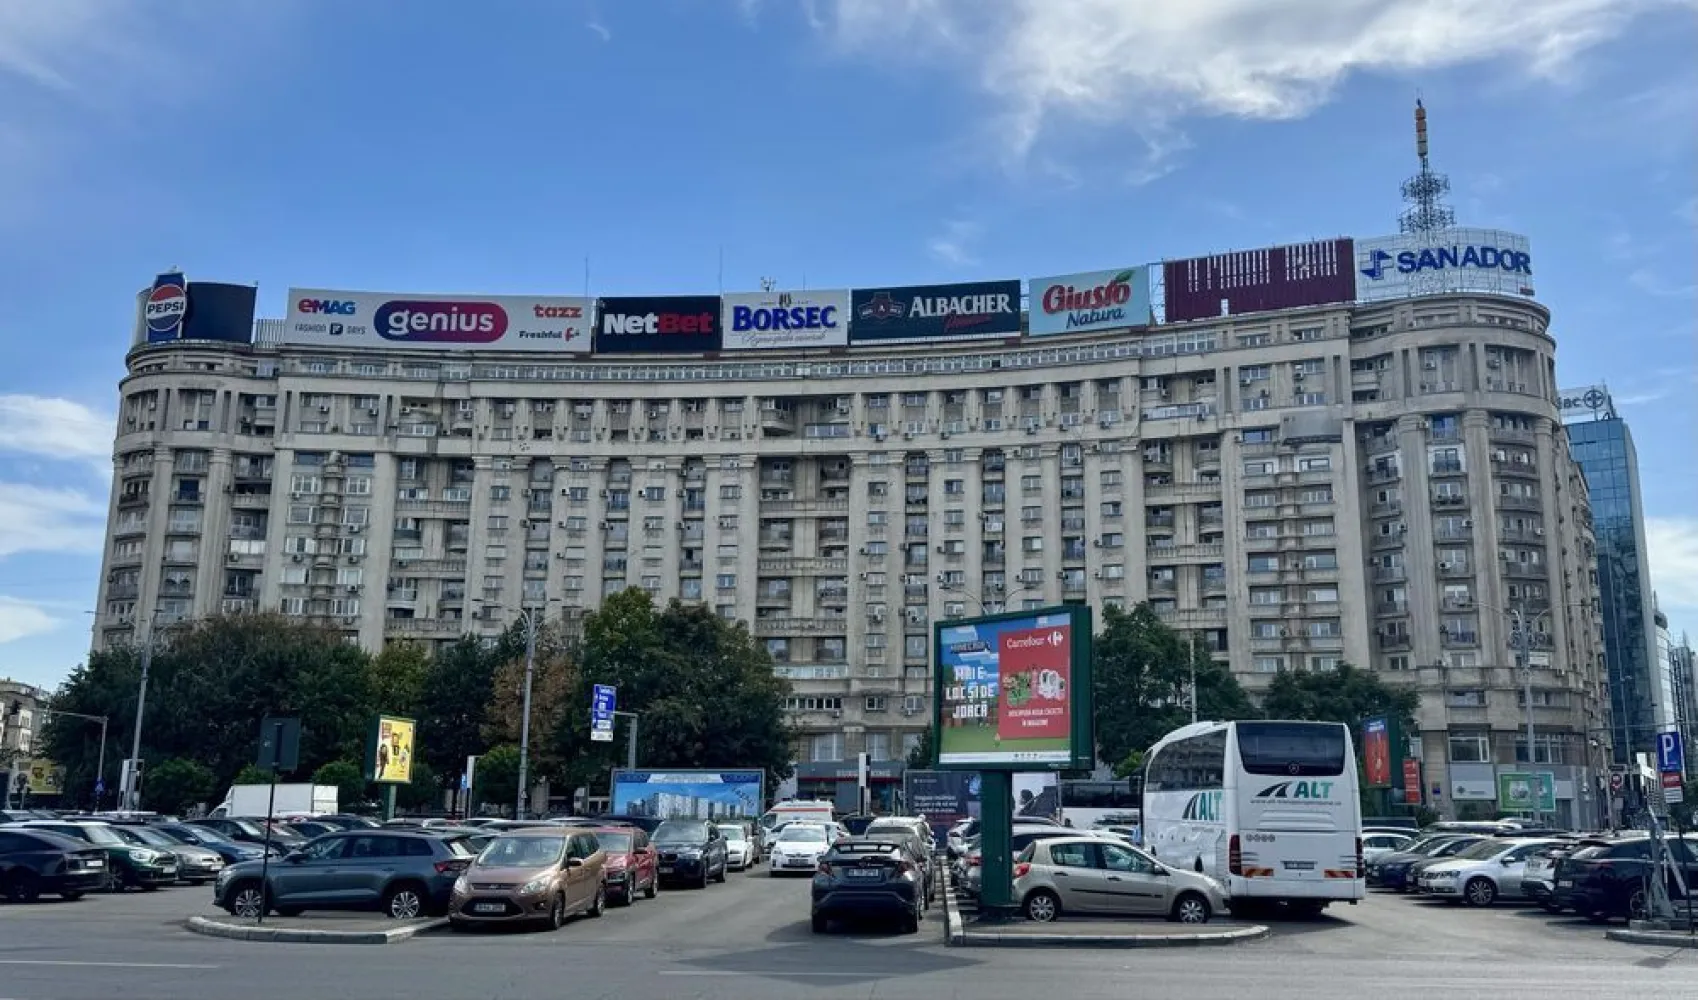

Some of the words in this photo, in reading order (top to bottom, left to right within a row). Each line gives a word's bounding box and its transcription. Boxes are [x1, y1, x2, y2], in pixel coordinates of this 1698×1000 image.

[1397, 245, 1533, 275] SANADOR
[147, 301, 184, 315] PEPSI
[298, 298, 356, 315] eMAG
[908, 293, 1013, 318] ALBACHER
[1042, 279, 1132, 315] Giusto
[387, 306, 495, 336] genius
[533, 303, 583, 318] tazz
[732, 305, 838, 332] BORSEC
[1065, 307, 1126, 329] Natura
[603, 312, 715, 335] NetBet
[1006, 635, 1045, 649] Carrefour
[945, 686, 967, 701] LOC
[1661, 734, 1675, 766] P
[1293, 780, 1334, 799] ALT
[1198, 791, 1223, 821] ALT
